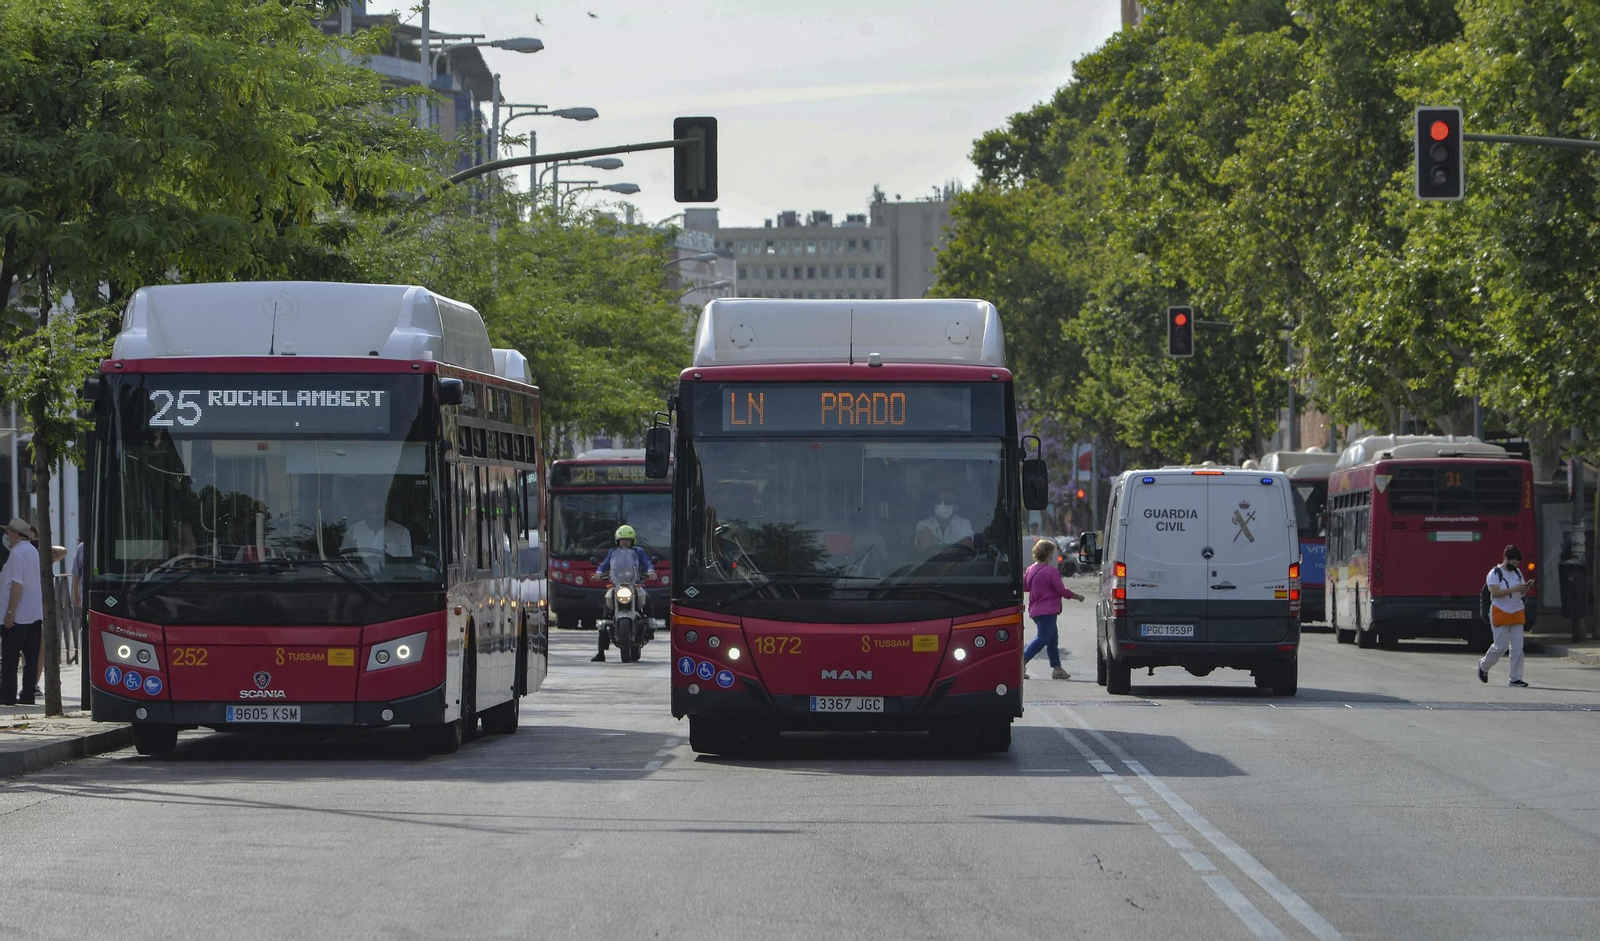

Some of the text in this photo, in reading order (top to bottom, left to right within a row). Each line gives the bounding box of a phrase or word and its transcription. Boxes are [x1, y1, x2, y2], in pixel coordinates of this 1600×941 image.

[149, 389, 384, 426] 25 ROCHELAMBERT
[730, 392, 906, 425] LN PRADO
[1446, 471, 1462, 487] 31
[1143, 508, 1198, 519] GUARDIA
[1155, 521, 1186, 532] CIVIL
[1147, 626, 1192, 635] PGC 1959P
[754, 636, 802, 654] 1872
[873, 639, 910, 648] TUSSAM
[172, 647, 208, 666] 252
[287, 652, 325, 661] TUSSAM
[821, 669, 873, 680] MAN
[239, 689, 287, 699] SCANIA
[819, 698, 881, 710] 3367 JGC
[235, 708, 297, 720] 9605 KSM
